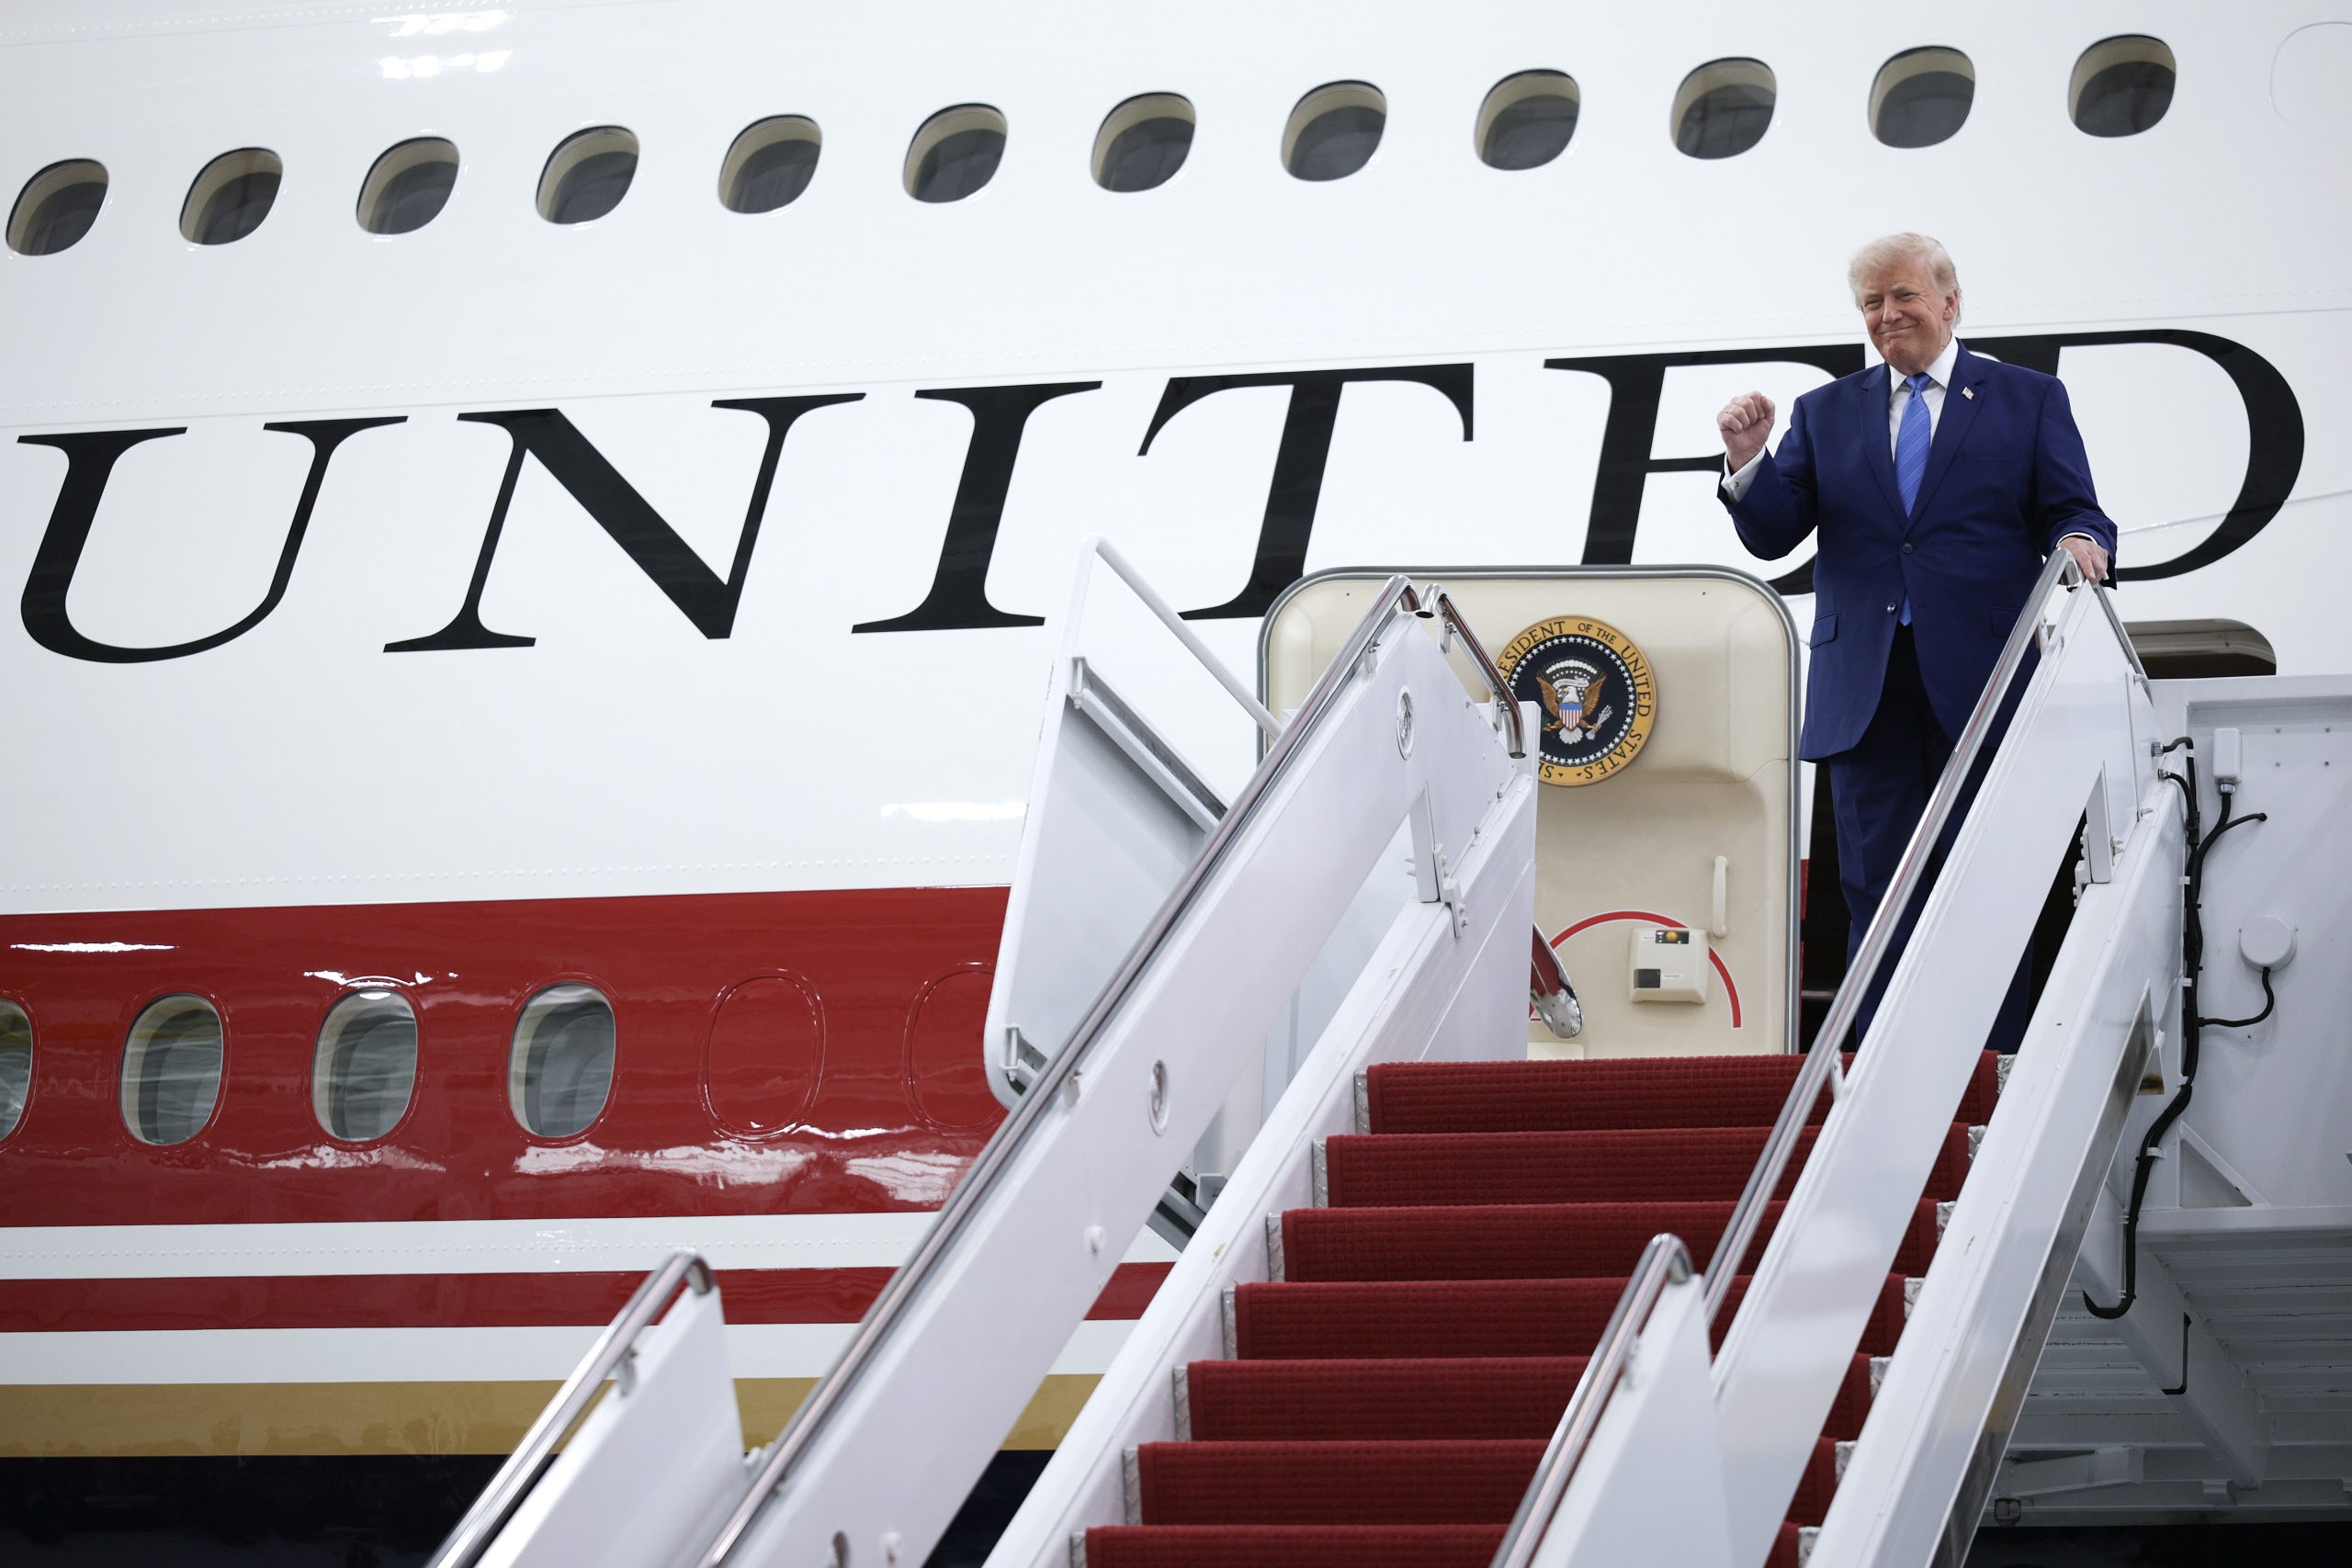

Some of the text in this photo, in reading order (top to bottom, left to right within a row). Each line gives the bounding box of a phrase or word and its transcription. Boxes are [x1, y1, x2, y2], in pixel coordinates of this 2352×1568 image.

[1498, 620, 1651, 780] ESIDENT OF THE UNITED STATES
